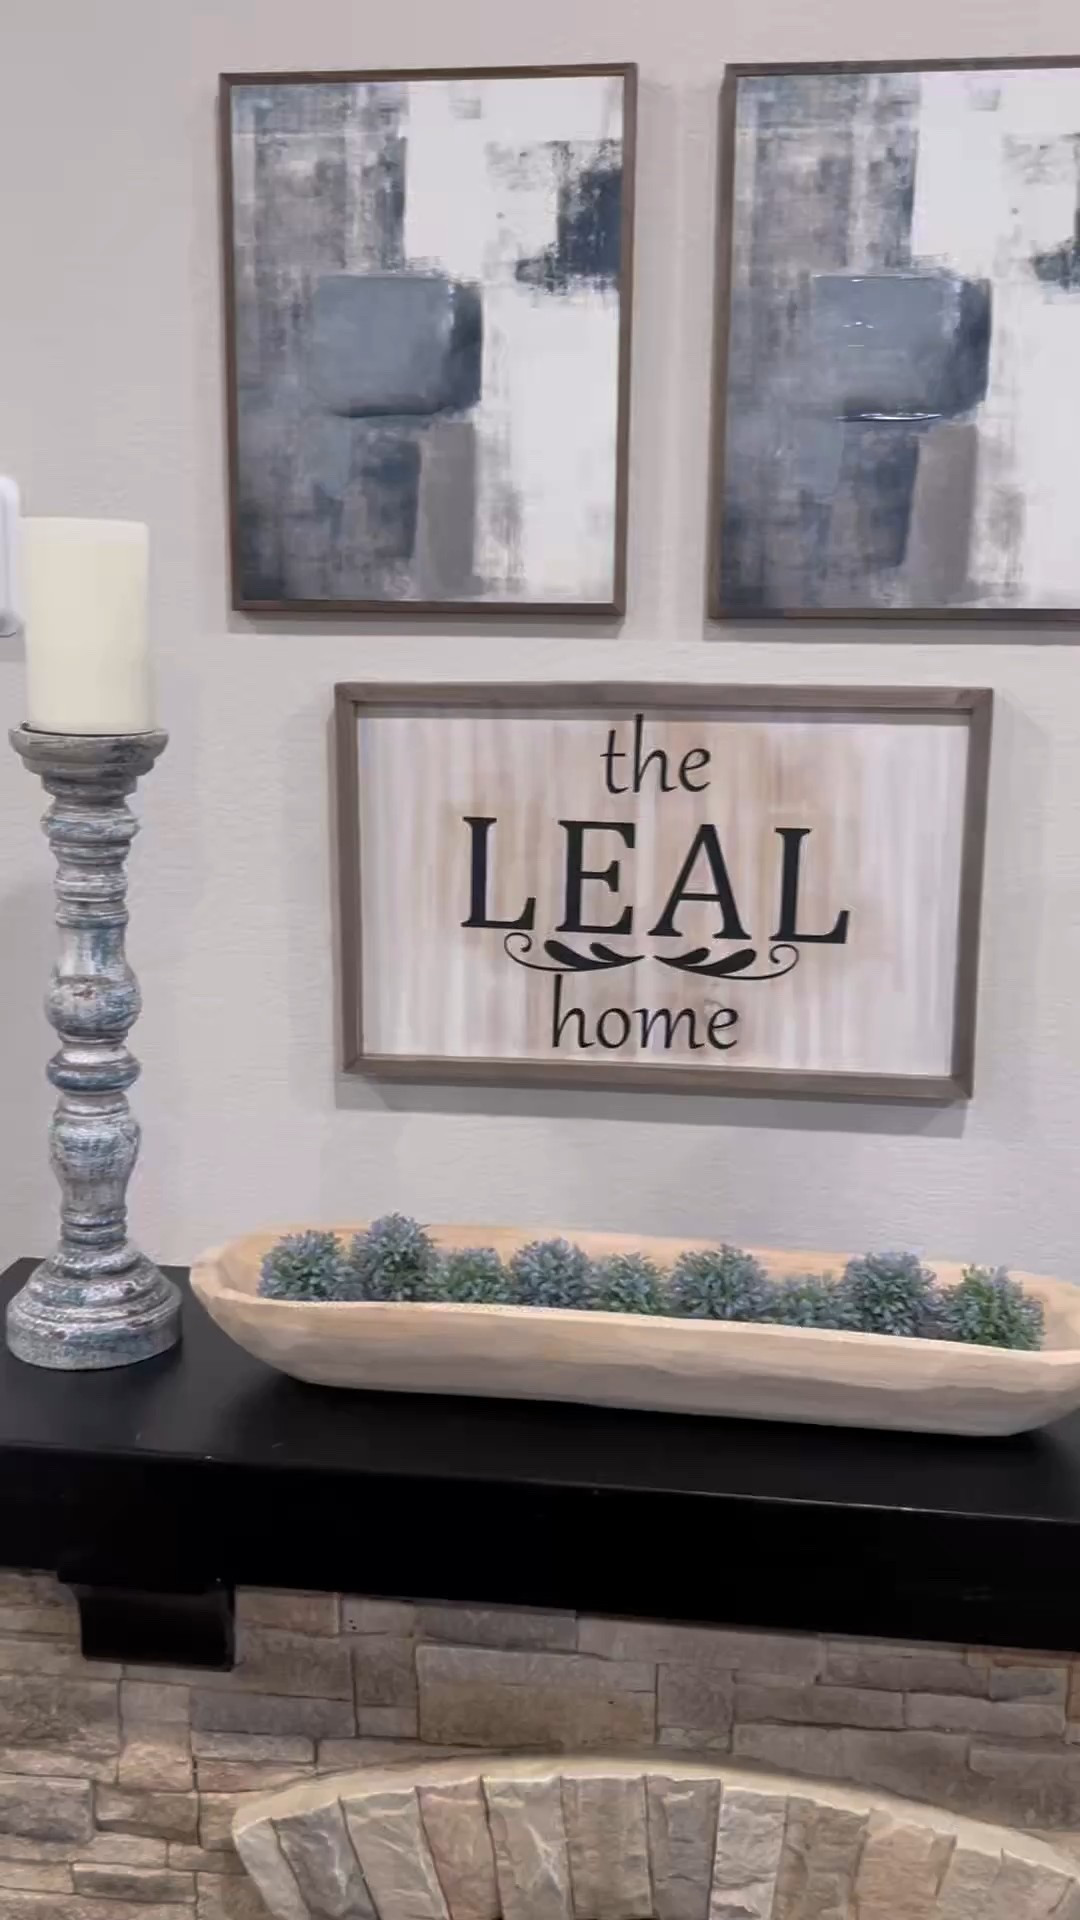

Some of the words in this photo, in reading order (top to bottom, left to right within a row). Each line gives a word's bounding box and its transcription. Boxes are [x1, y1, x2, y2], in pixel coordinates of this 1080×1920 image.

[600, 713, 711, 794] the
[461, 816, 850, 945] LEAL
[552, 974, 739, 1050] home
